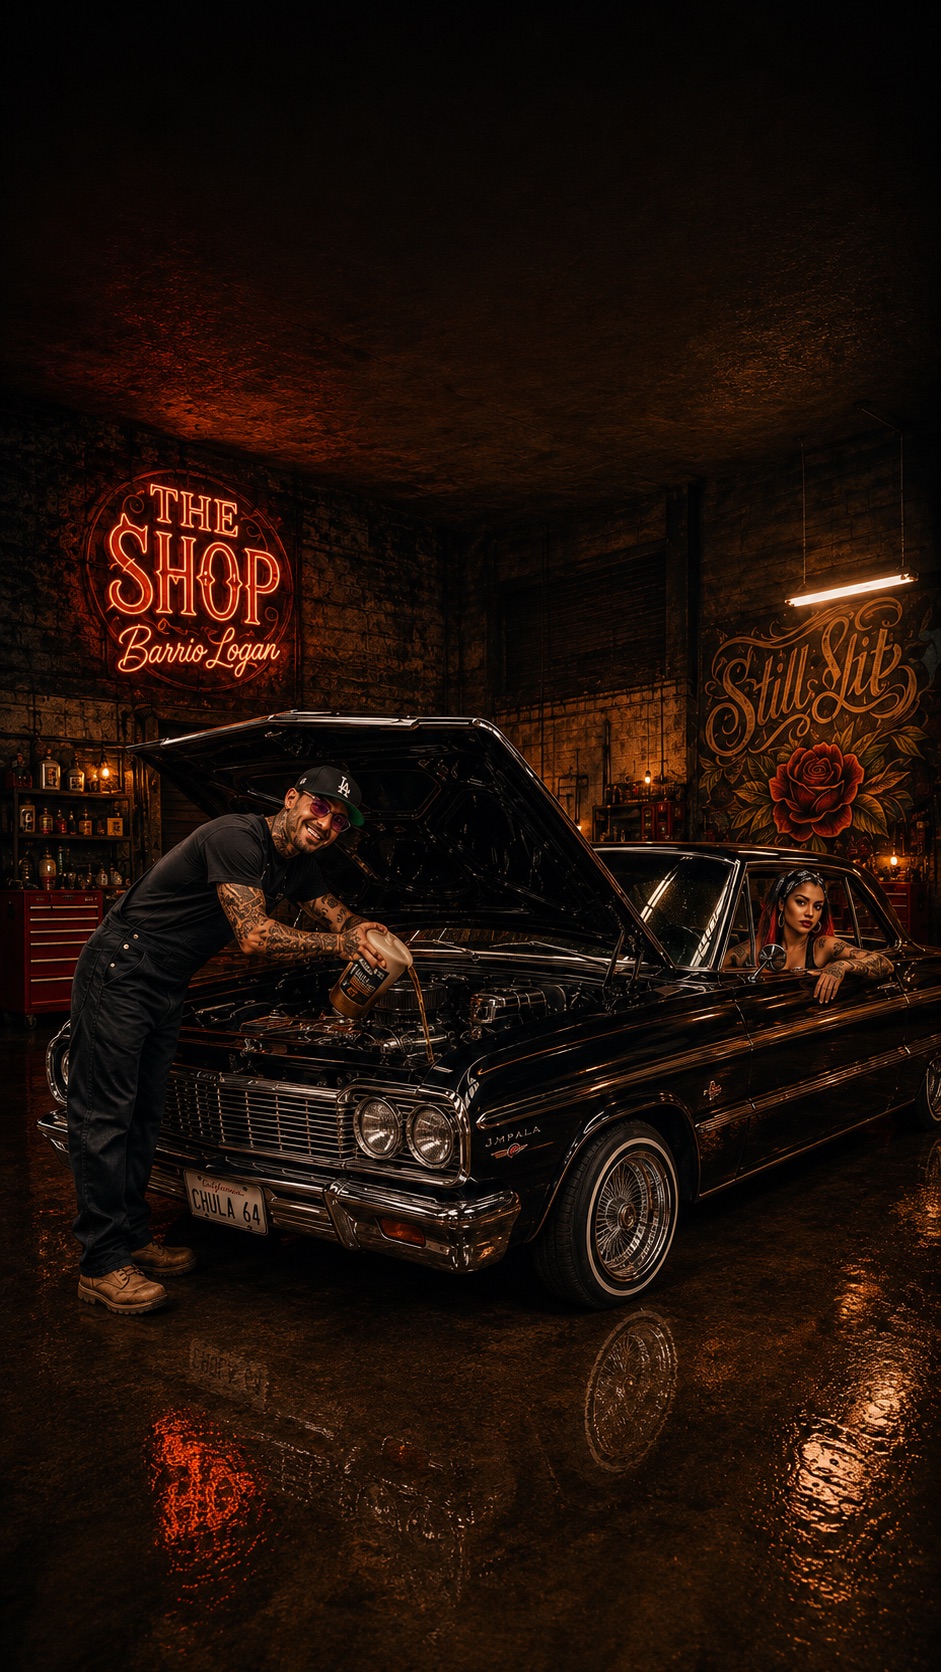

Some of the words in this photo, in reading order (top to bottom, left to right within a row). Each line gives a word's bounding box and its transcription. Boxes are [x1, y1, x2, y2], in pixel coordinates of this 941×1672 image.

[150, 483, 239, 538] THE
[108, 512, 281, 626] SHOP
[117, 624, 209, 672] Barrio
[205, 626, 281, 678] Logan
[704, 642, 812, 757] Still
[337, 775, 351, 799] LA
[192, 1188, 236, 1219] CHULA
[243, 1201, 260, 1225] 64
